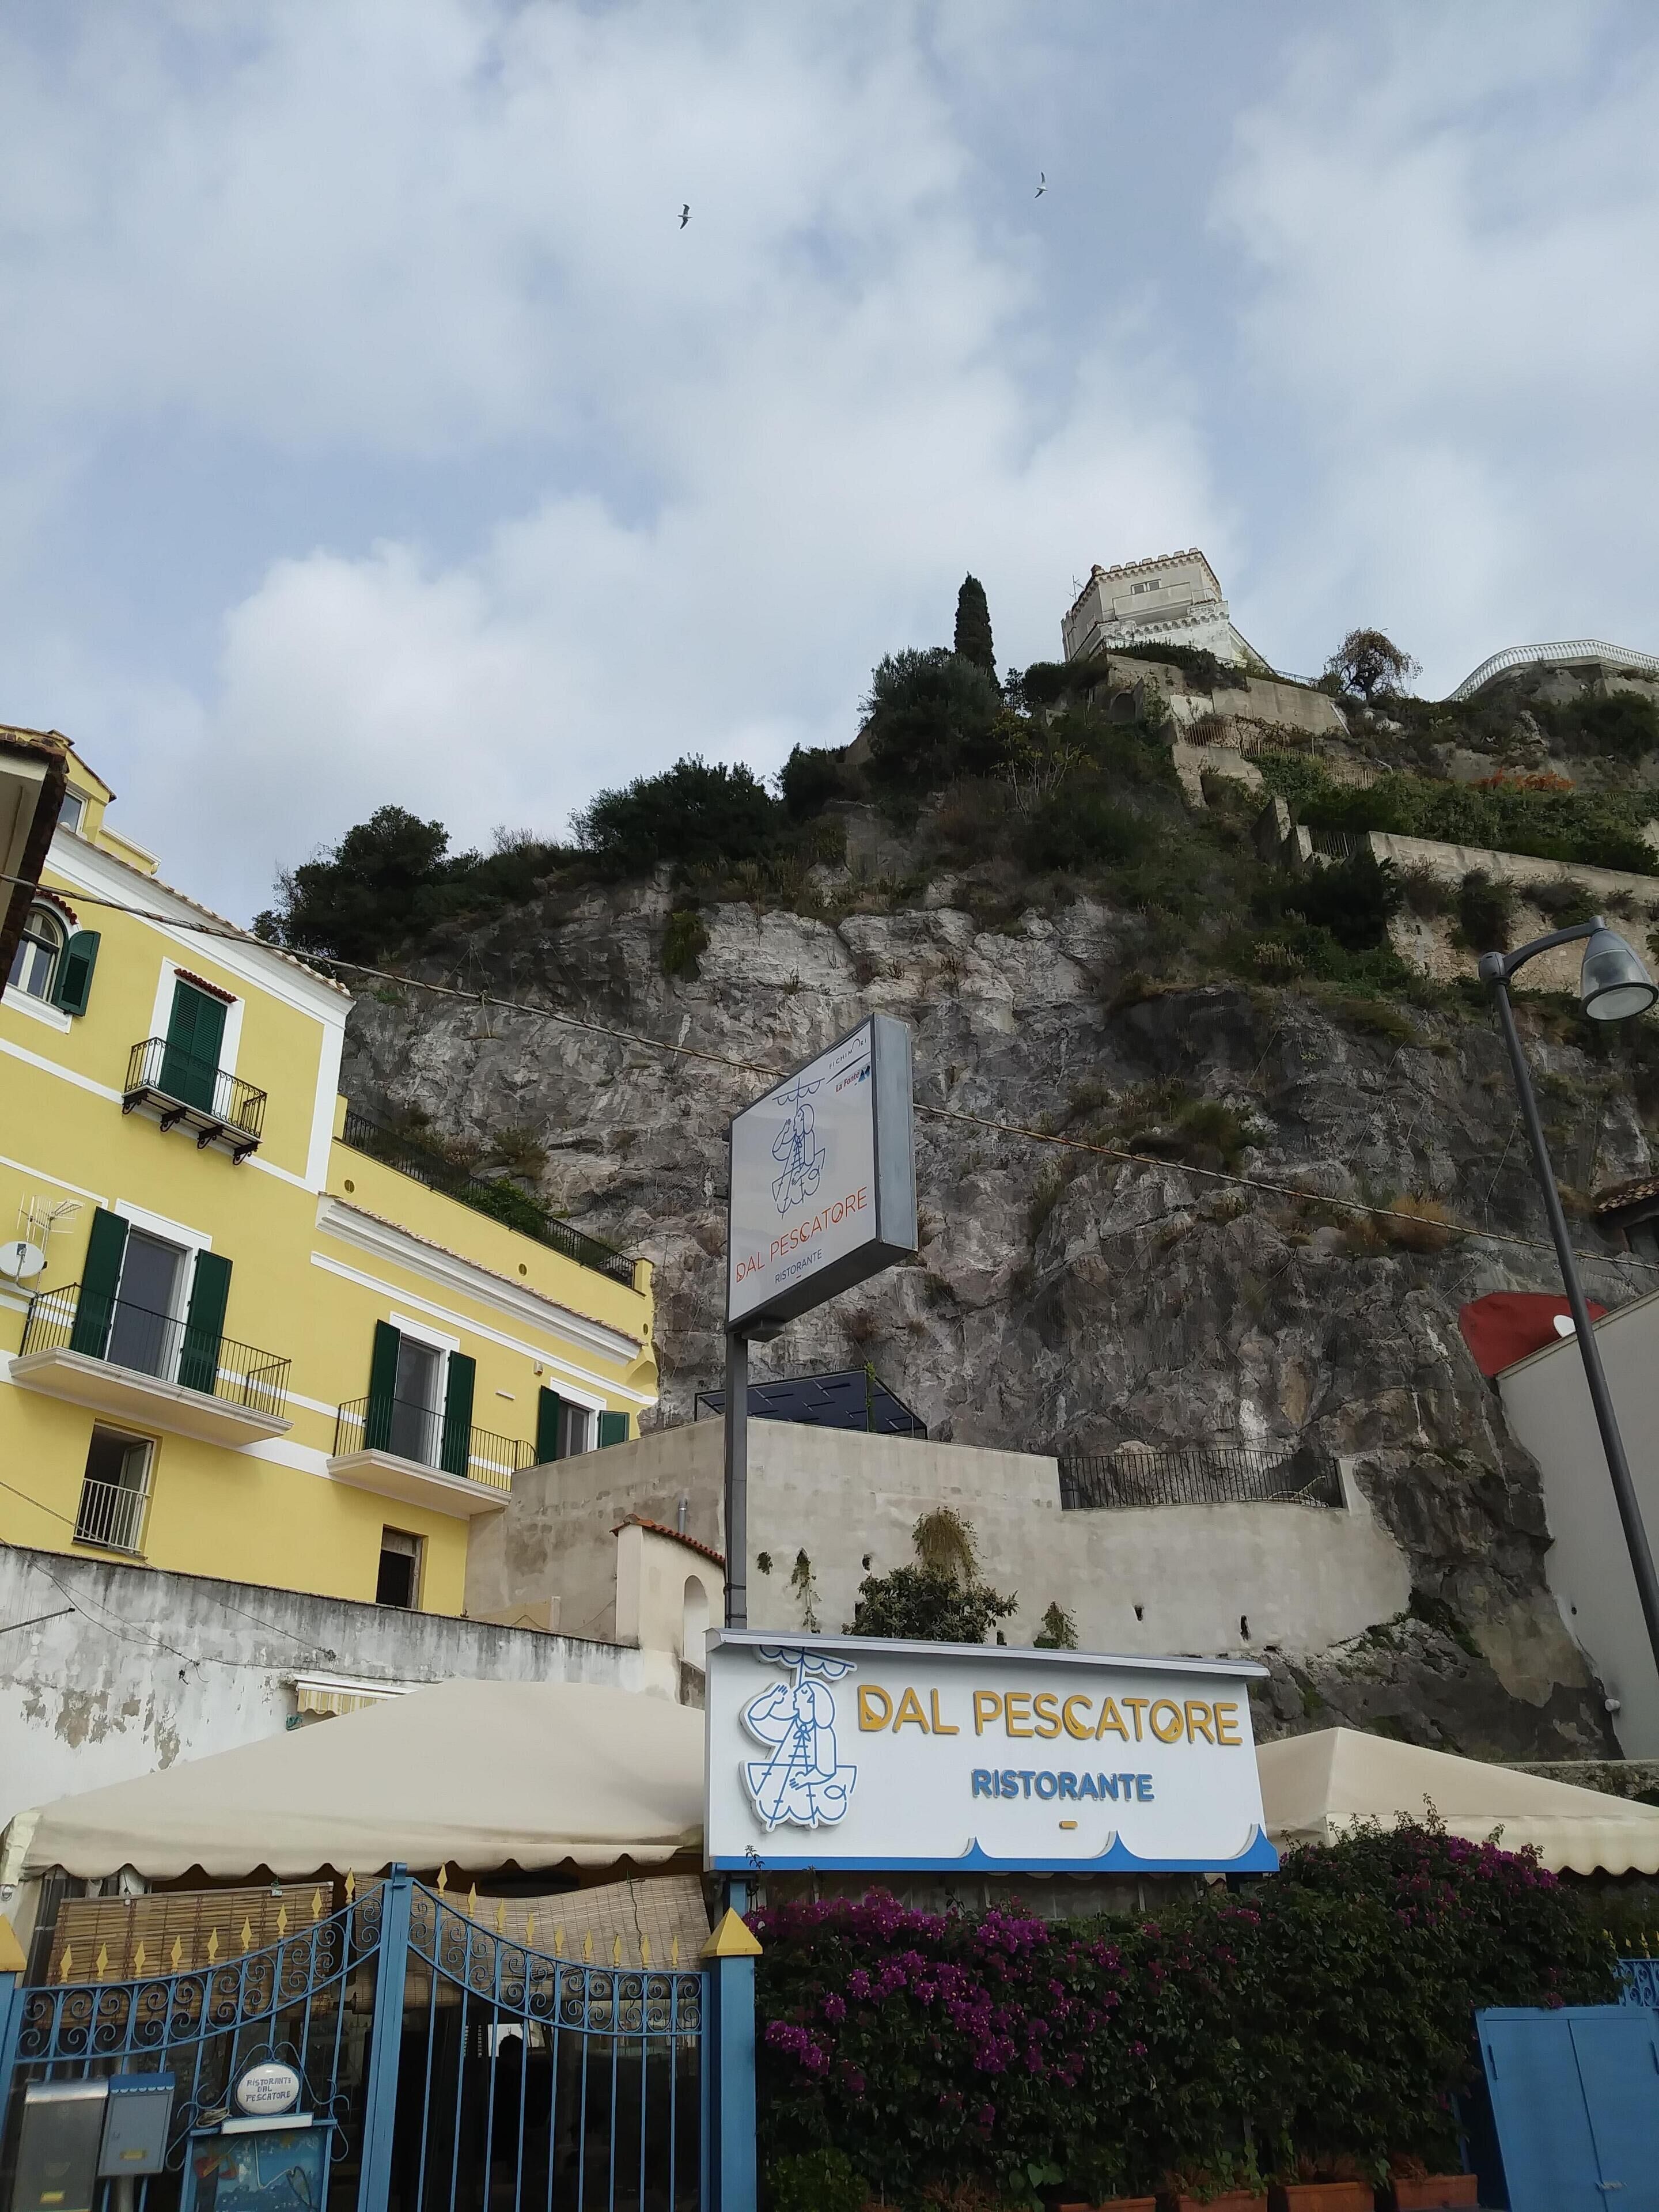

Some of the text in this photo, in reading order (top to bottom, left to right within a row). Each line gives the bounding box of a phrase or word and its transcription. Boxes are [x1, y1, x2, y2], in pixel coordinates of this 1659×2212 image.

[836, 1071, 860, 1092] La Fonte
[736, 1186, 868, 1283] DAL PESCATORE
[775, 1248, 823, 1284] RISTORANTE
[858, 1684, 1243, 1745] DAL PESCATORE
[971, 1769, 1154, 1801] RISTORANTE
[246, 2091, 290, 2101] PESCATORE
